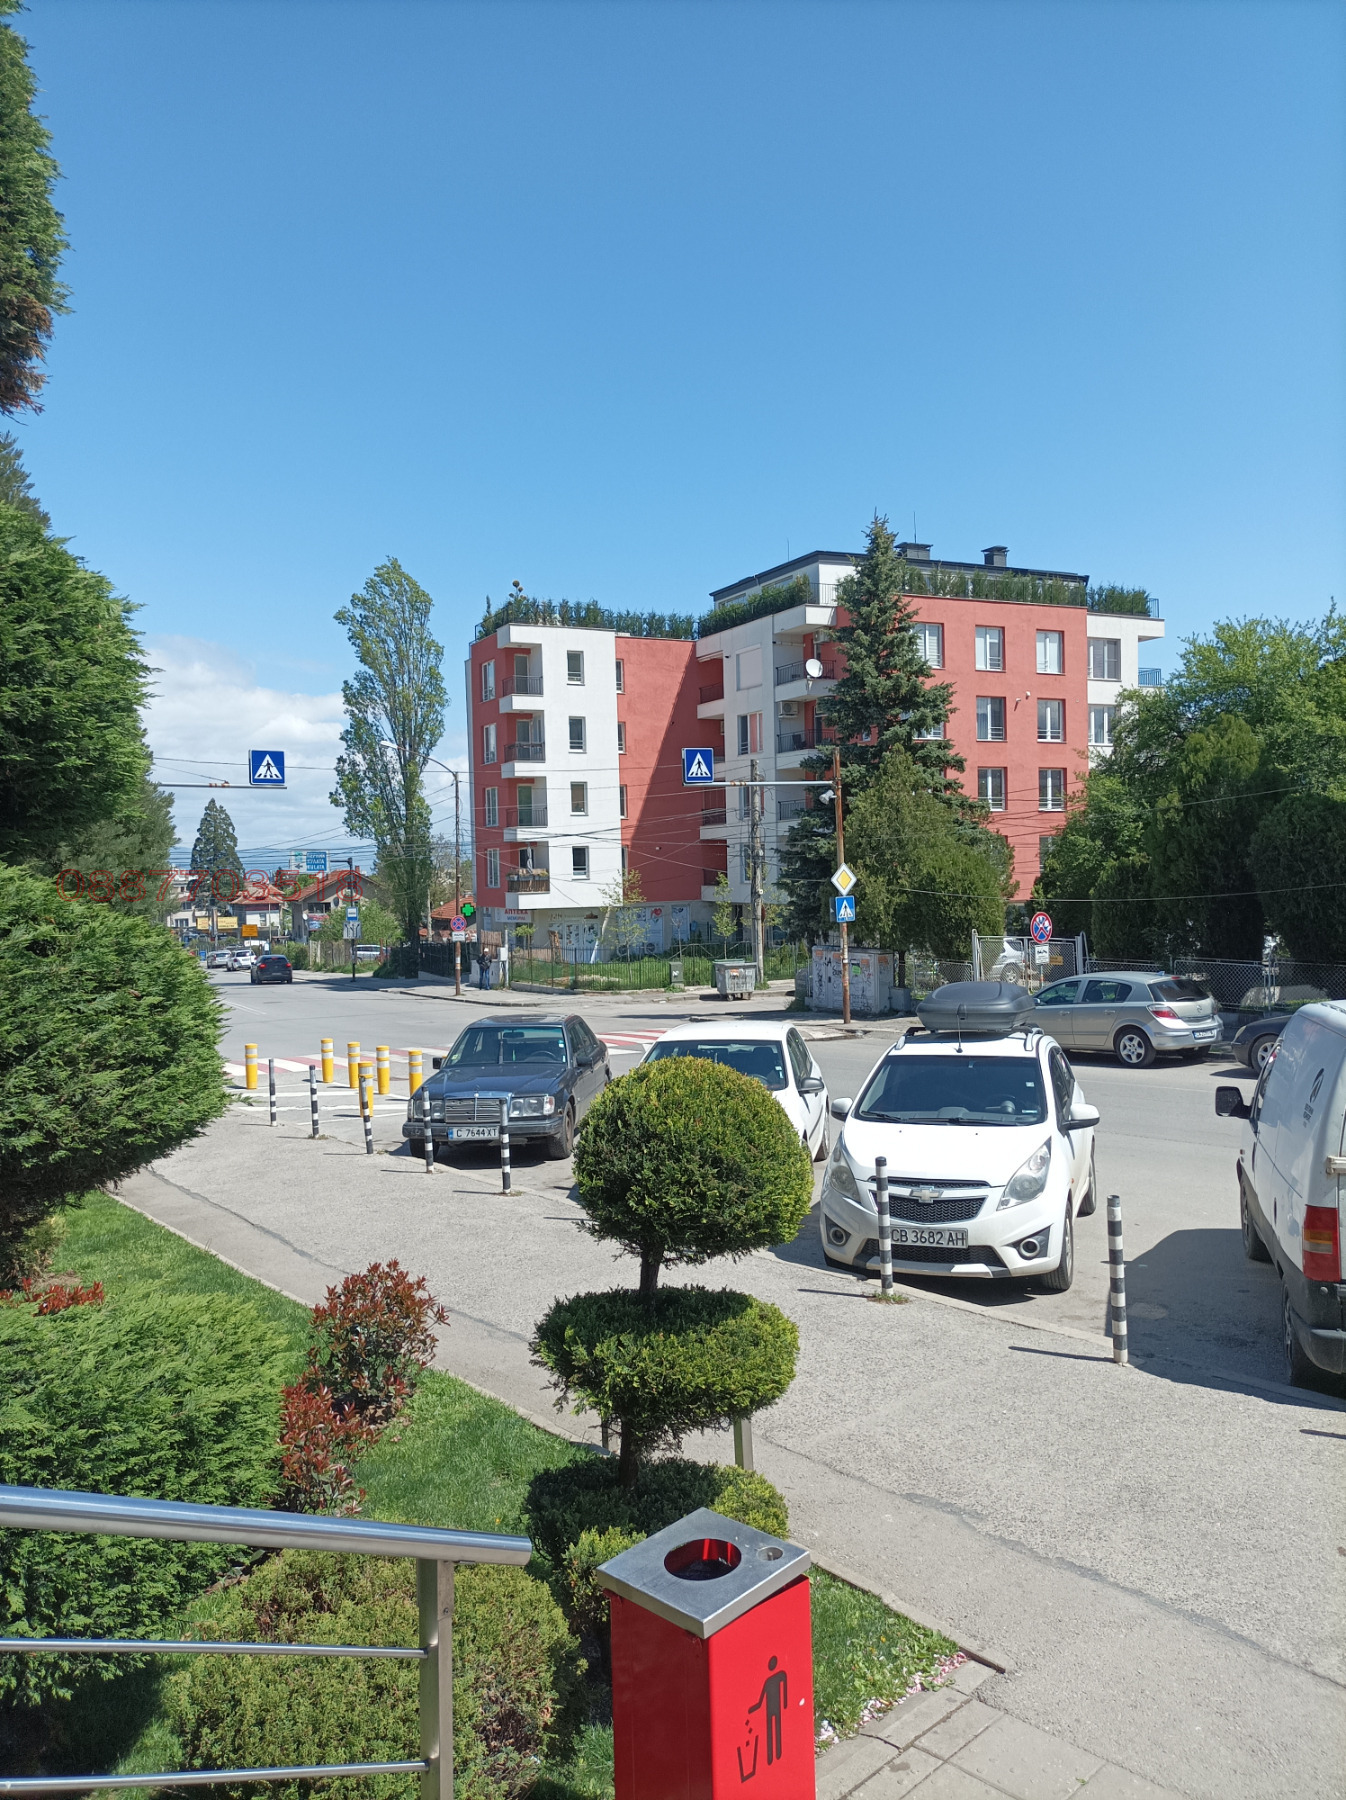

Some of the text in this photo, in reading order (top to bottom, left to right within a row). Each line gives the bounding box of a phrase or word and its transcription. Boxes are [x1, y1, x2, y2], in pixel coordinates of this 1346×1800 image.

[456, 1128, 497, 1138] C 7644 XT
[891, 1229, 965, 1246] CB 3682 AH
